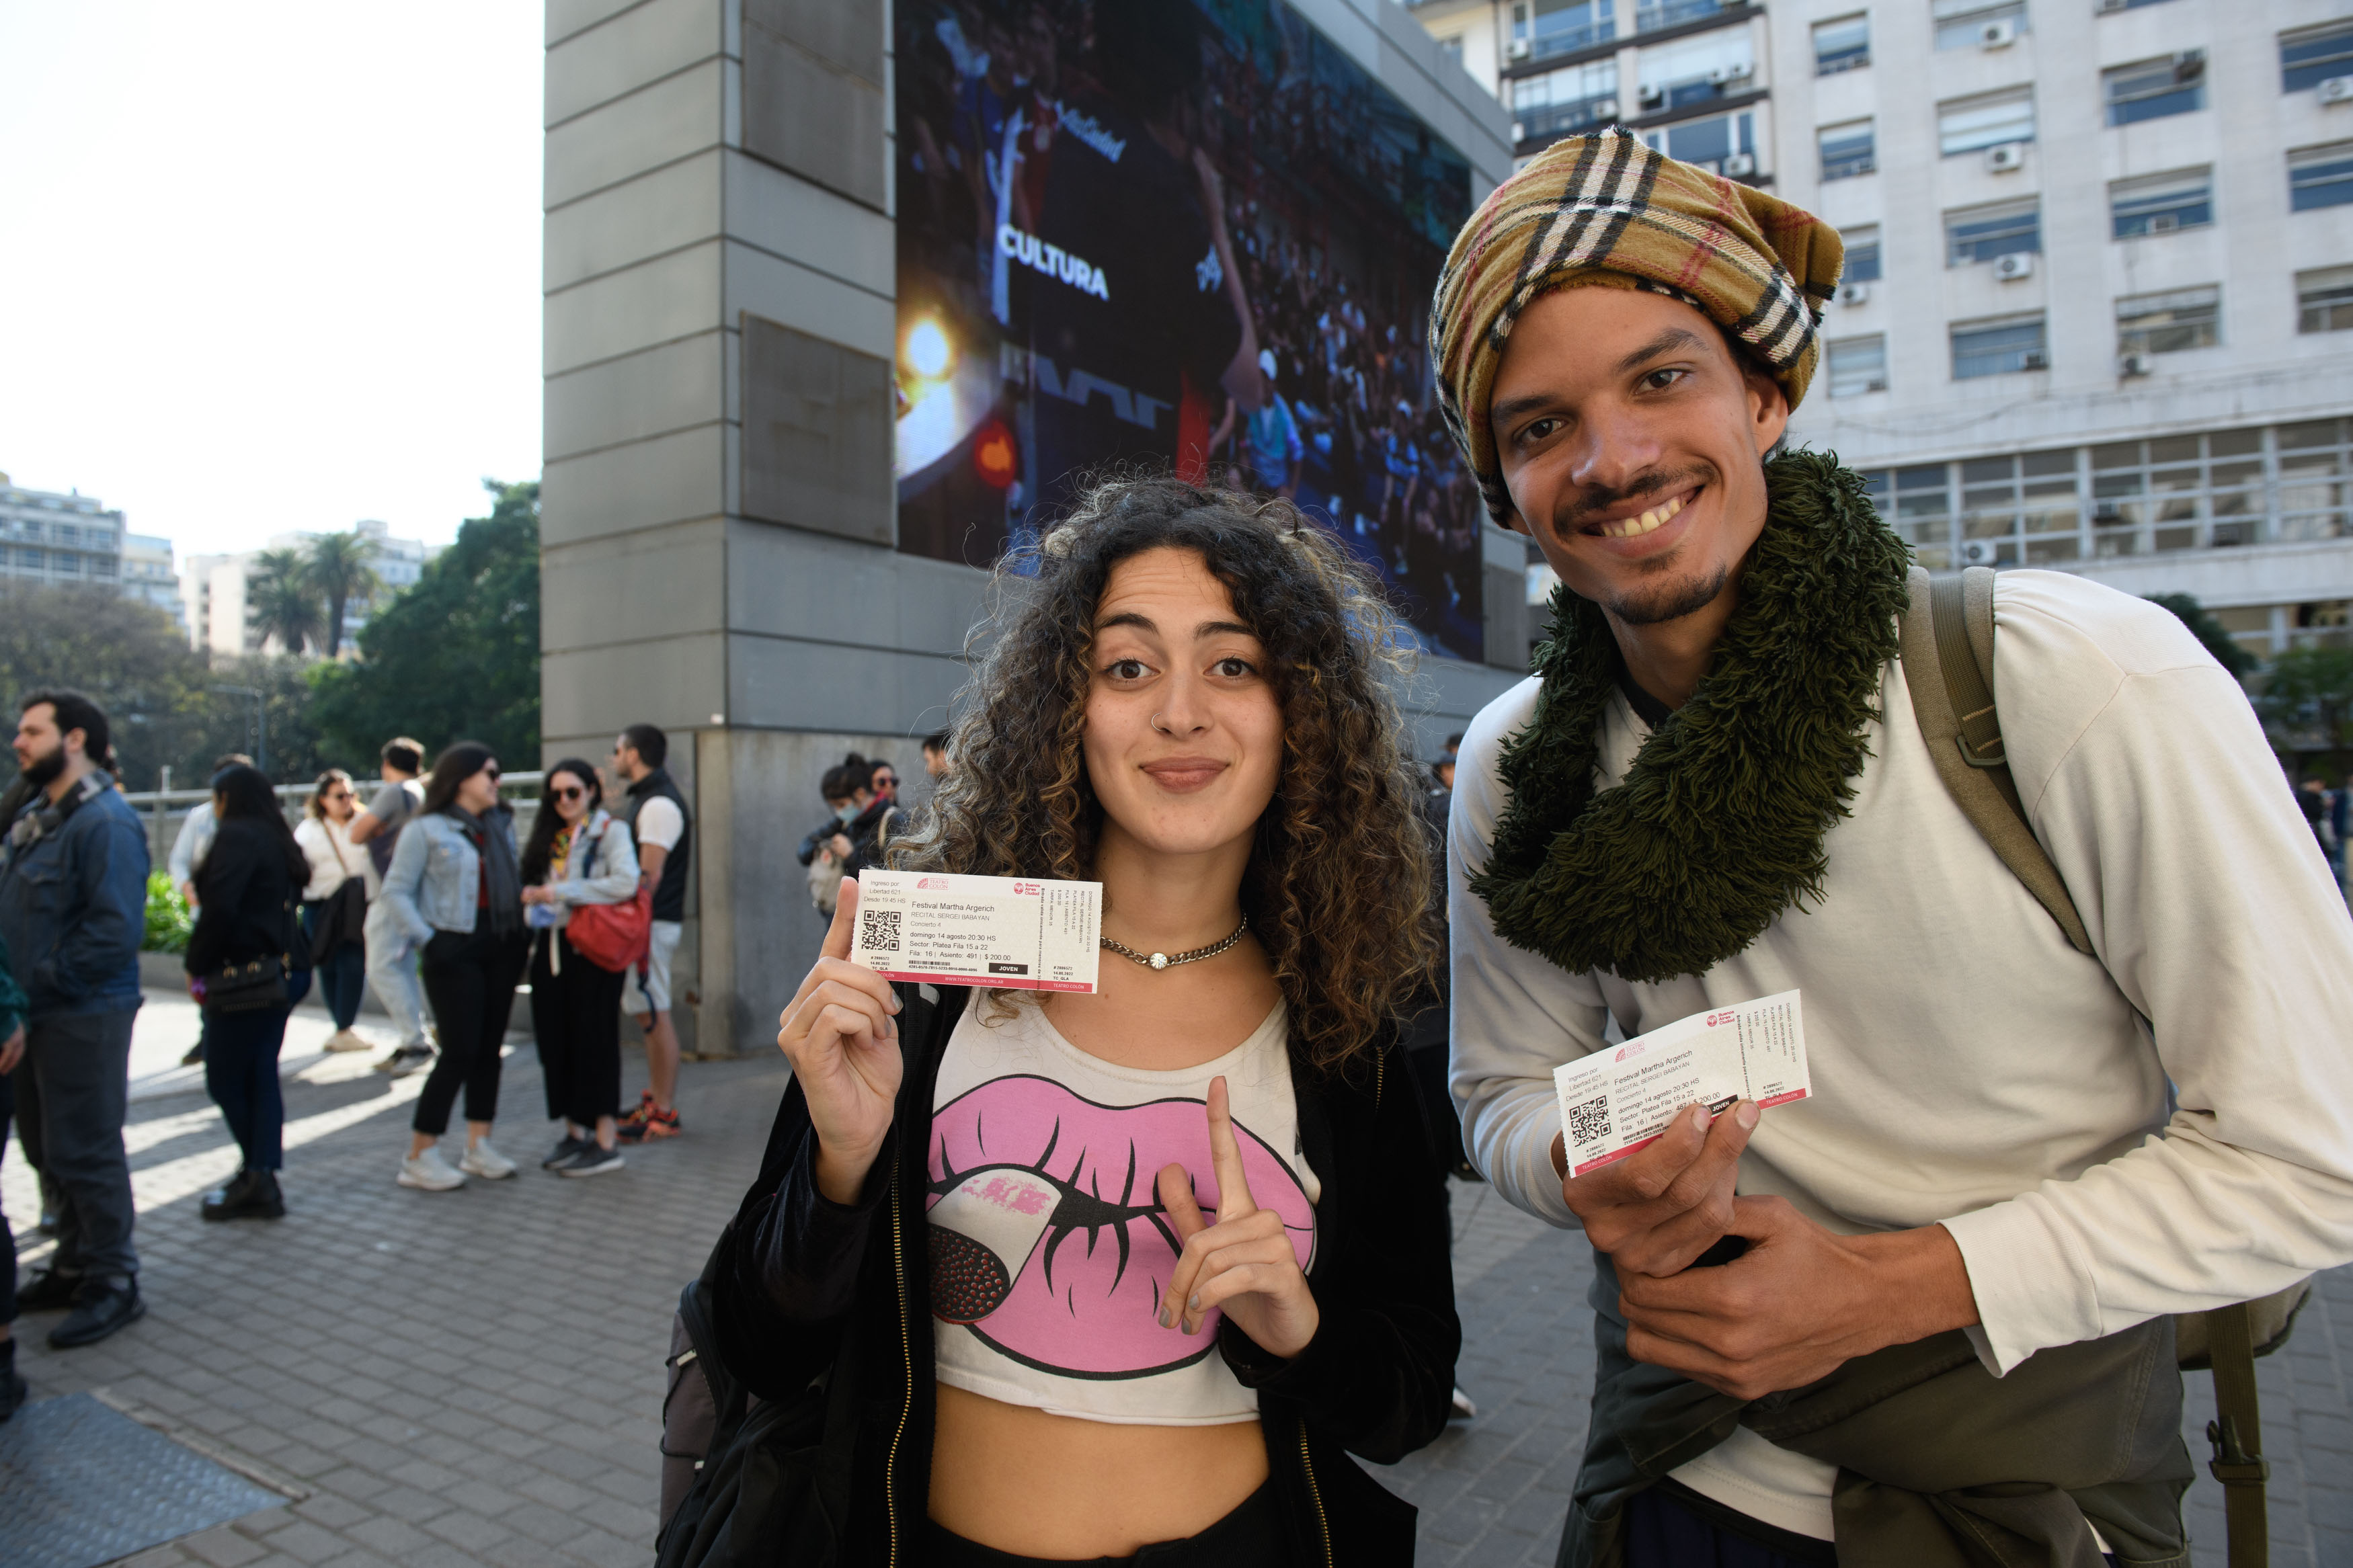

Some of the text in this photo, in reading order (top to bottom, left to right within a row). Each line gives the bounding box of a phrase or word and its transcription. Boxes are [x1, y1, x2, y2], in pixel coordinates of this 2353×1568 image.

[998, 222, 1109, 301] CULTURA
[912, 901, 938, 909] Festival
[966, 904, 995, 913] Argerich
[945, 977, 1004, 985] WWW.TEATROCOLON.ORG.AR
[1627, 1042, 1644, 1052] TEATRO
[1614, 1050, 1693, 1085] Festival Martha Argerich
[1568, 1071, 1589, 1083] Ingreso
[1616, 1061, 1690, 1095] RECITAL SERGEI BABAYAN
[1566, 1091, 1583, 1102] Desde
[1600, 1081, 1608, 1089] HS
[1569, 1078, 1591, 1091] Libertad
[1617, 1091, 1642, 1104] Concierto
[1618, 1102, 1643, 1114] domingo
[1652, 1090, 1672, 1102] agosto
[1691, 1077, 1700, 1085] HS
[1766, 1097, 1782, 1105] TEATRO
[1620, 1112, 1640, 1123] Sector:
[1642, 1104, 1660, 1115] Platea
[1661, 1100, 1672, 1109] Fila
[1621, 1124, 1634, 1132] Fila:
[1651, 1110, 1674, 1121] Asiento:
[1676, 1102, 1687, 1111] 487
[1700, 1091, 1720, 1104] 200.00
[1712, 1100, 1730, 1112] JOVEN
[1582, 1155, 1612, 1170] TEATRO COLÓN
